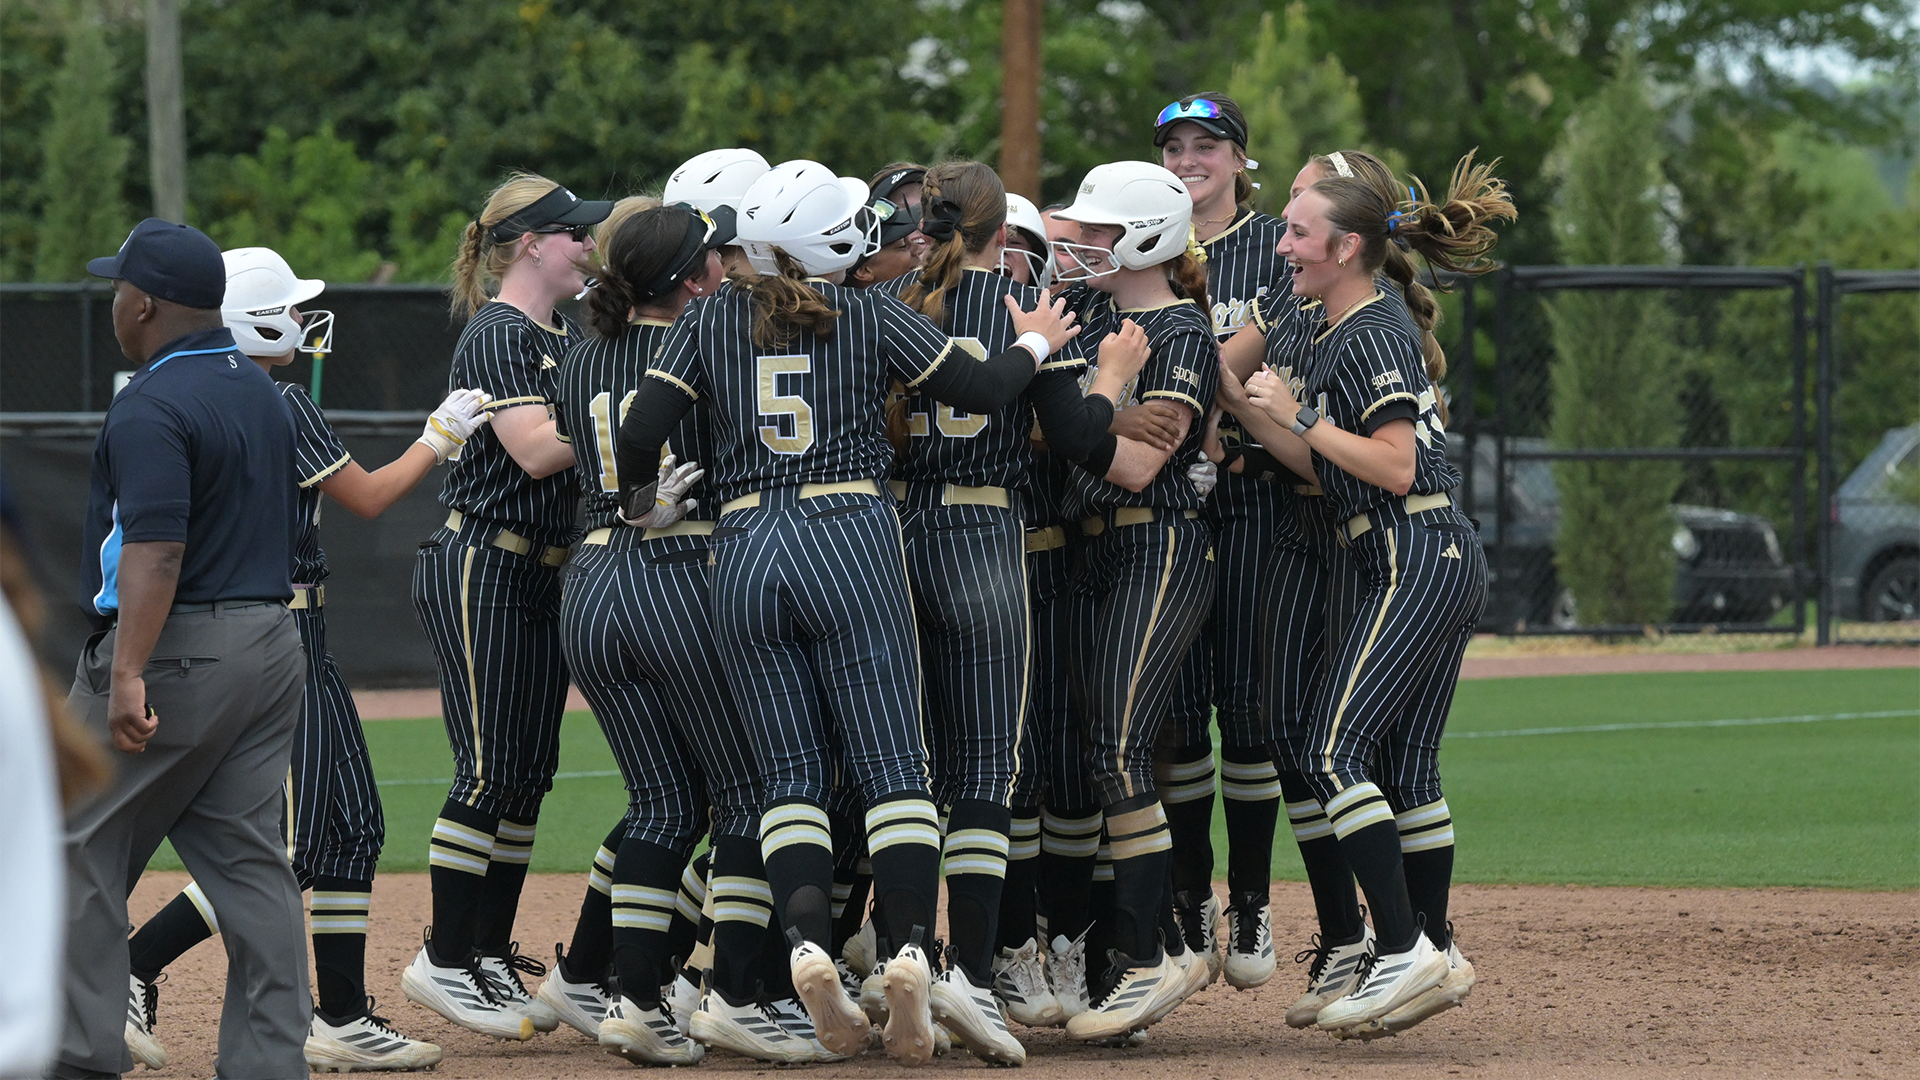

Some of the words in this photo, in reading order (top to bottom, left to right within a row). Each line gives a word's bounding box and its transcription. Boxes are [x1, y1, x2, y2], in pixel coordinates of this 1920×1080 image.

[255, 306, 283, 316] EASTON
[1371, 369, 1402, 390] SOCON
[756, 354, 814, 454] 5
